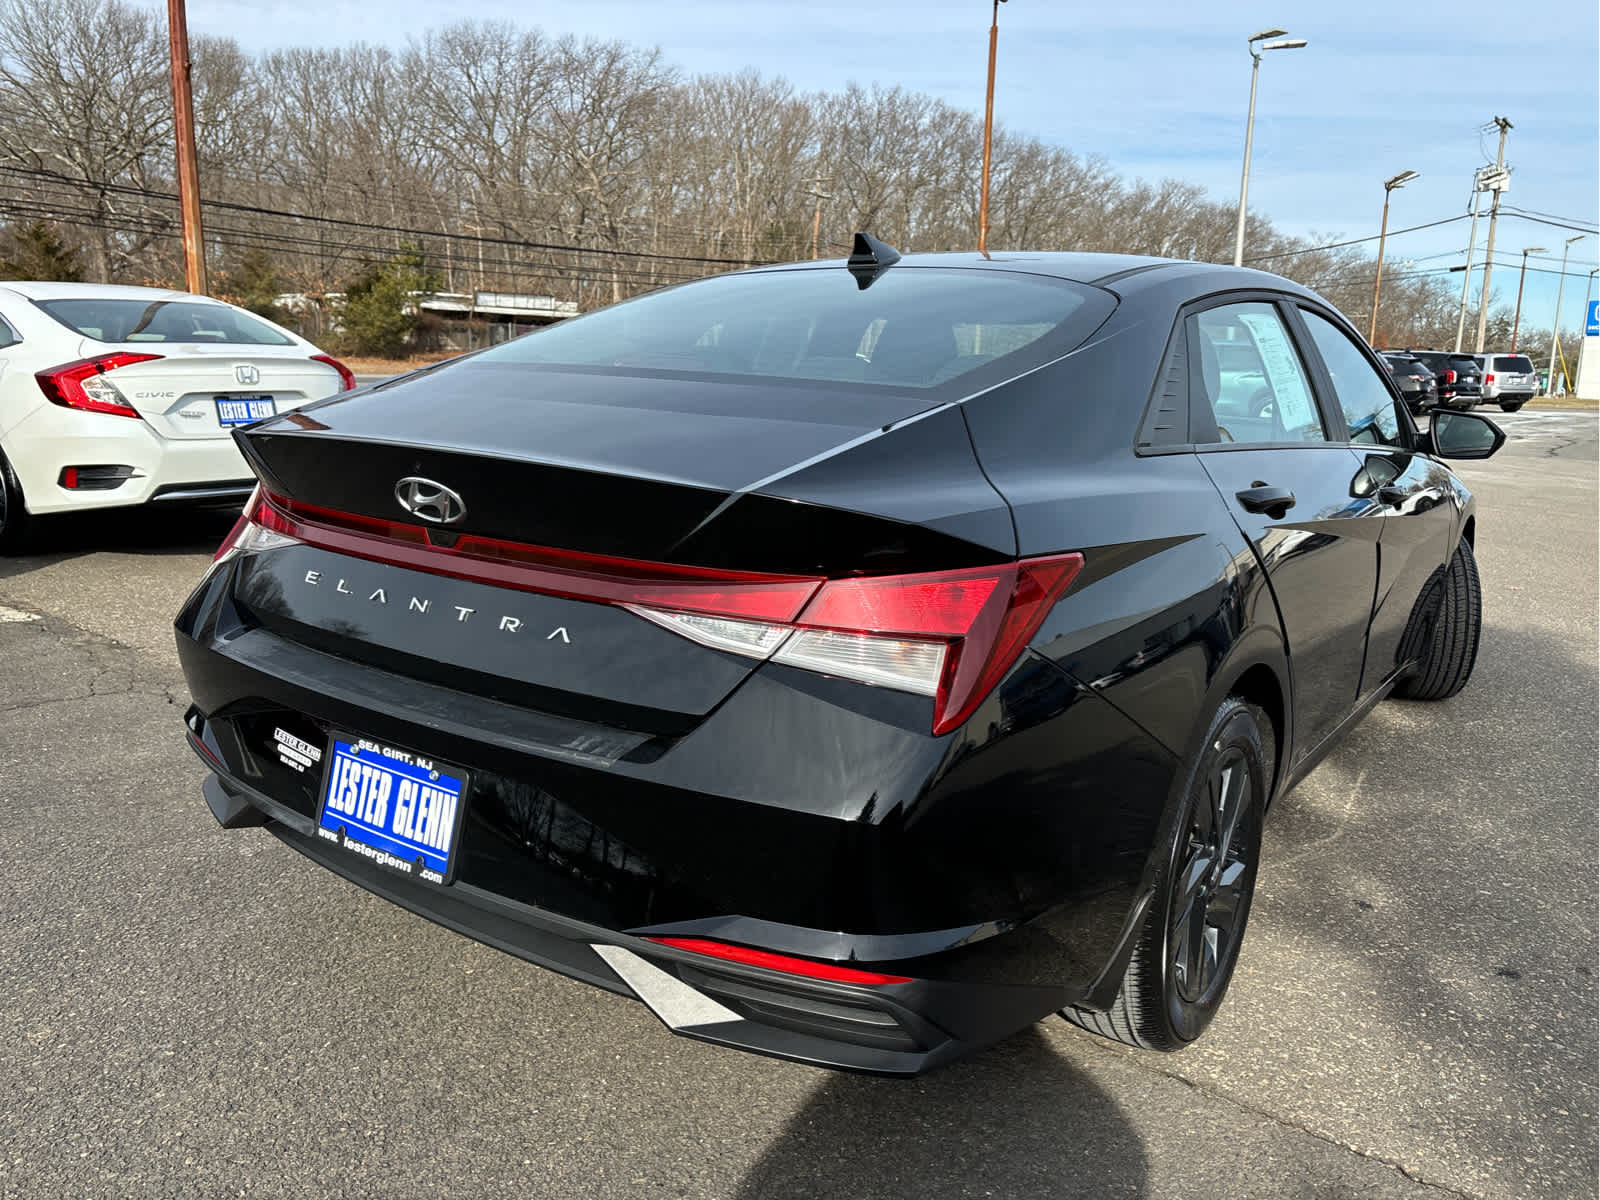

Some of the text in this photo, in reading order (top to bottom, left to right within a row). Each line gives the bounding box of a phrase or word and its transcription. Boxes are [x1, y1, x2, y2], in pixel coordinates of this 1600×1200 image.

[135, 391, 176, 399] CIVIC
[218, 402, 249, 419] LESTER
[248, 401, 275, 418] GLENN
[305, 570, 571, 644] ELANTRA
[275, 729, 298, 750] LESTER
[358, 739, 434, 771] SEA GIRT, NJ
[327, 755, 458, 853] LESTER GLENN
[343, 836, 412, 873] lesterglenn
[419, 869, 443, 884] .com
